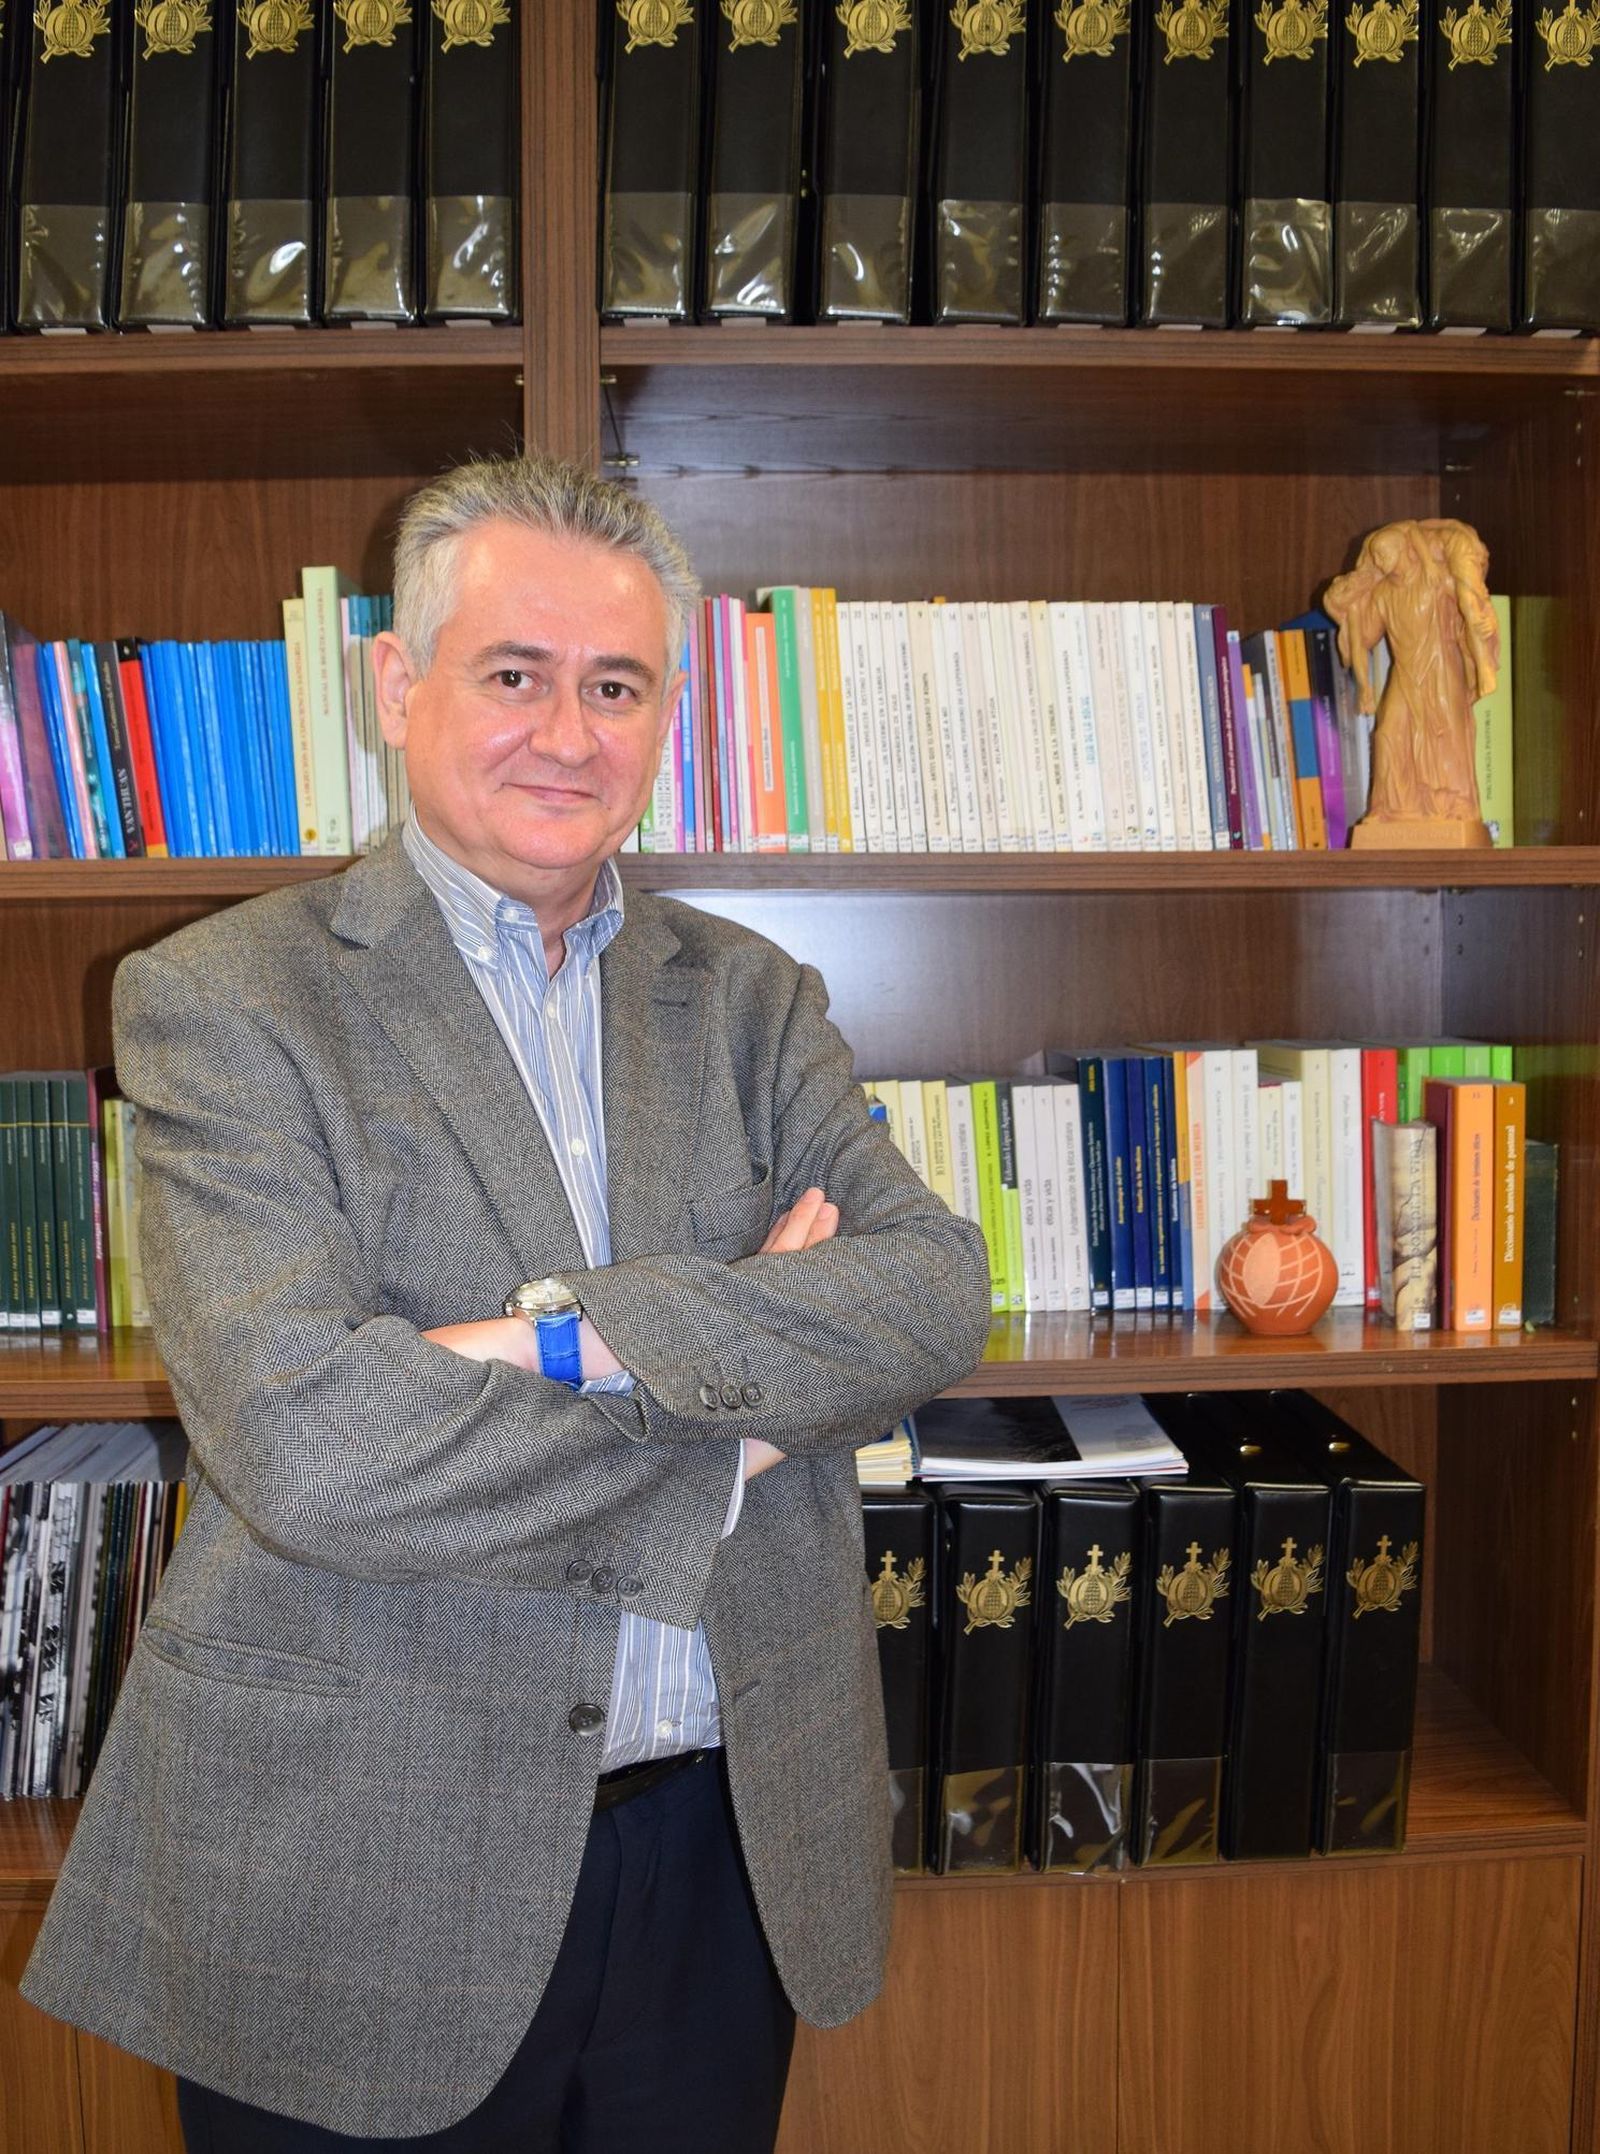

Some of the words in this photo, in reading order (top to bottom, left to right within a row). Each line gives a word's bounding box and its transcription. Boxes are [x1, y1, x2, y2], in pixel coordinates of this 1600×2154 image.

[118, 767, 130, 807] THUAN
[124, 809, 134, 833] VAN
[1065, 1121, 1073, 1148] cristiana
[1507, 1125, 1516, 1158] pastoral
[1025, 1205, 1034, 1225] ética
[1045, 1205, 1053, 1225] ética
[1506, 1214, 1514, 1262] Diccionario
